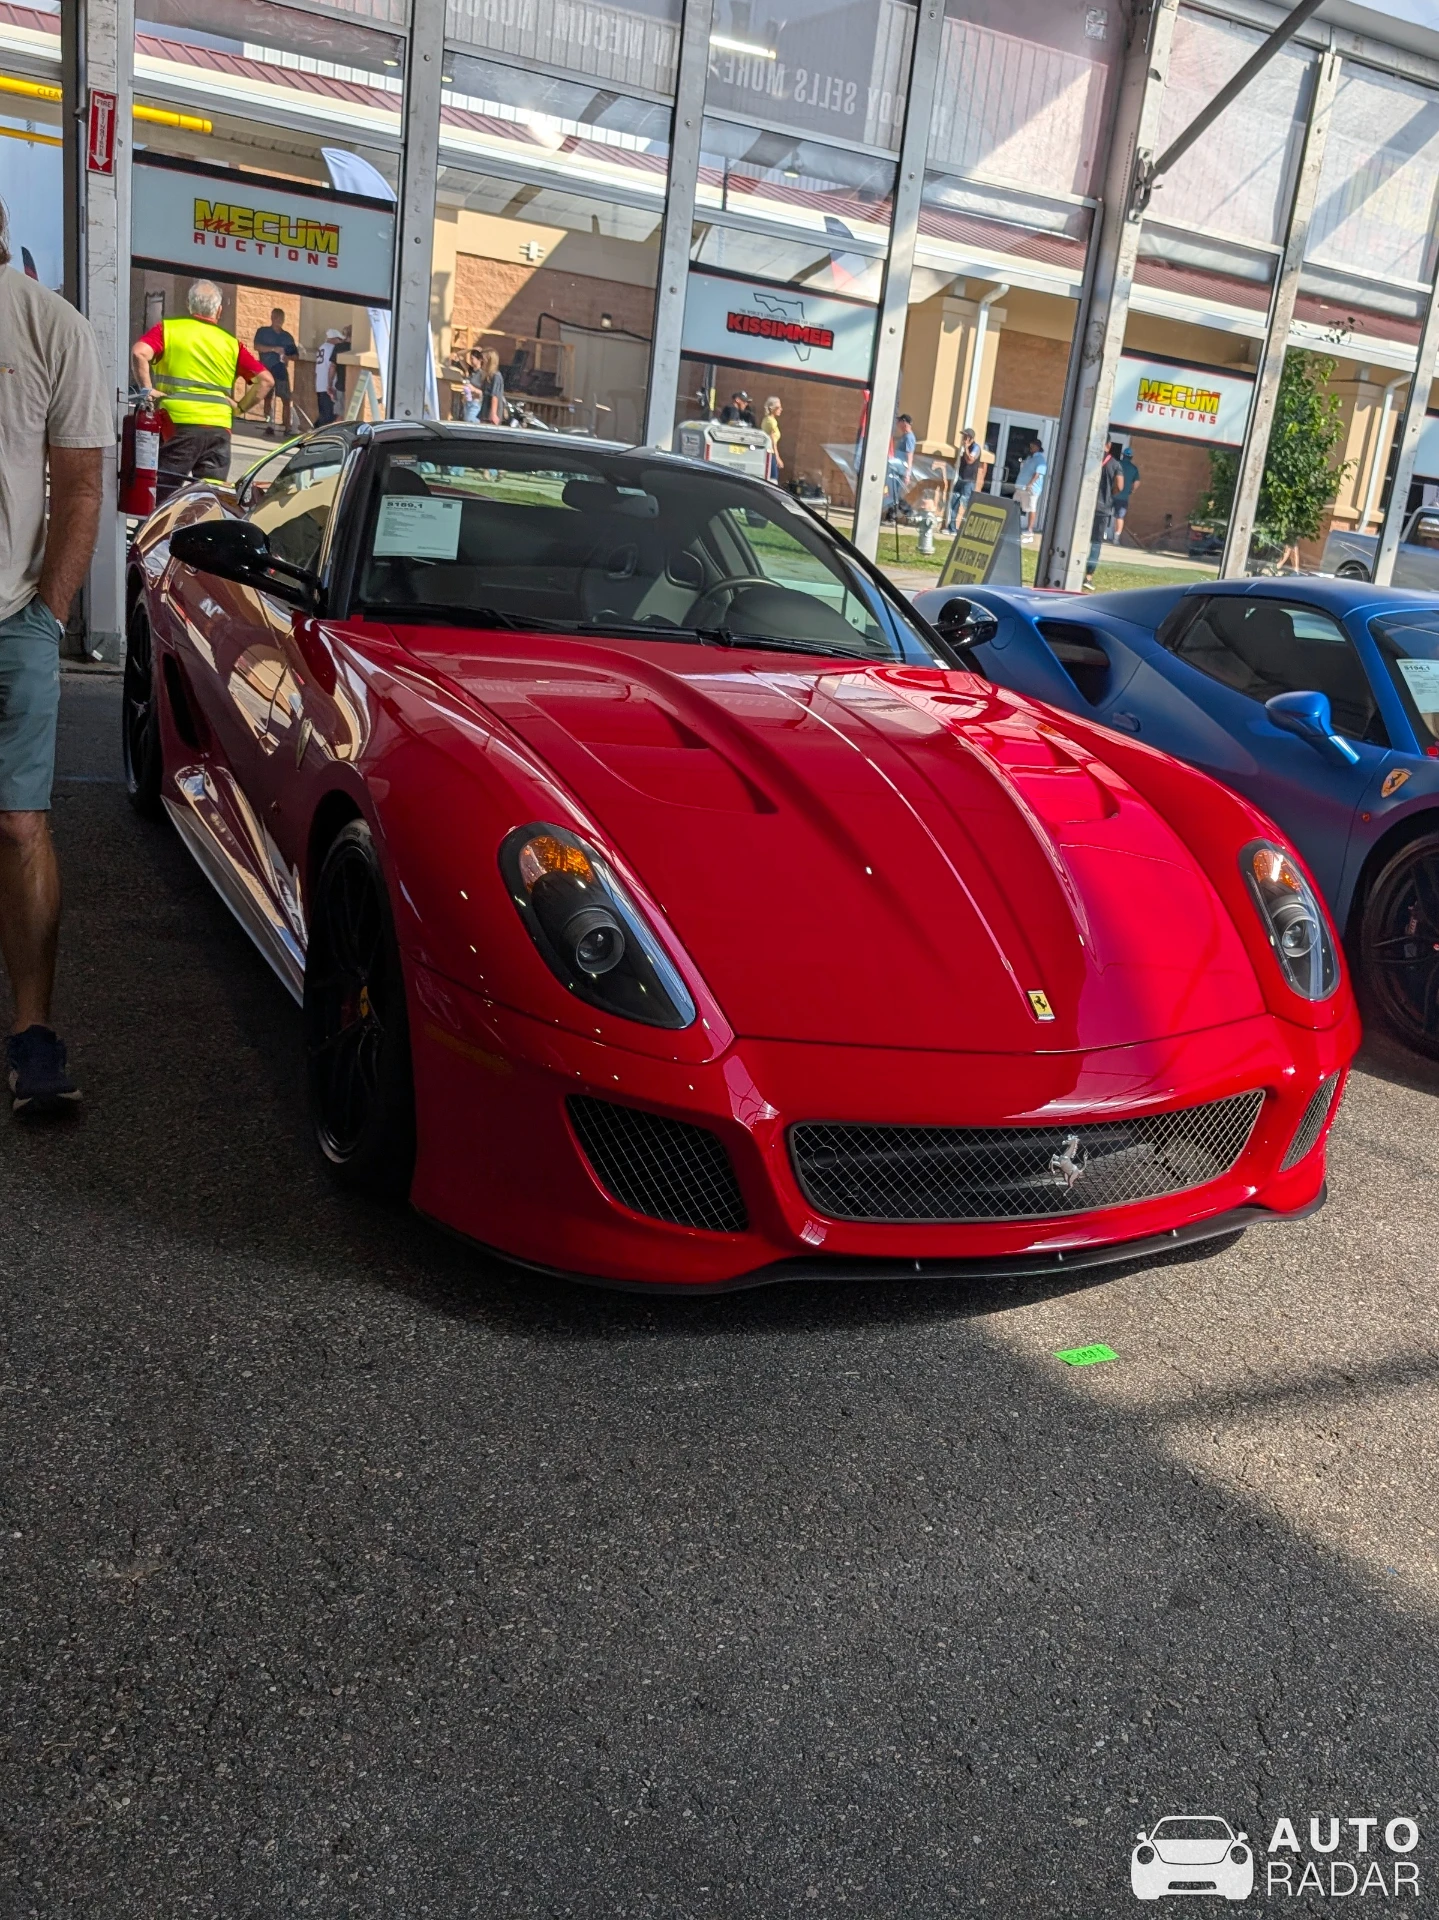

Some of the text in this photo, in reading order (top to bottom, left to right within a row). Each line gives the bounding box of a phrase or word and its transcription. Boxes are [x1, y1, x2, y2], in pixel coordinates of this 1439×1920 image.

[37, 88, 62, 99] CLEA
[97, 99, 112, 108] FIRE
[194, 198, 340, 255] MECUM
[194, 232, 338, 268] AUCTIONS
[727, 312, 834, 350] KISSIMMEE
[1137, 377, 1221, 415] MECUM
[1136, 402, 1217, 424] AUCTIONS
[964, 515, 1002, 543] CAUTION
